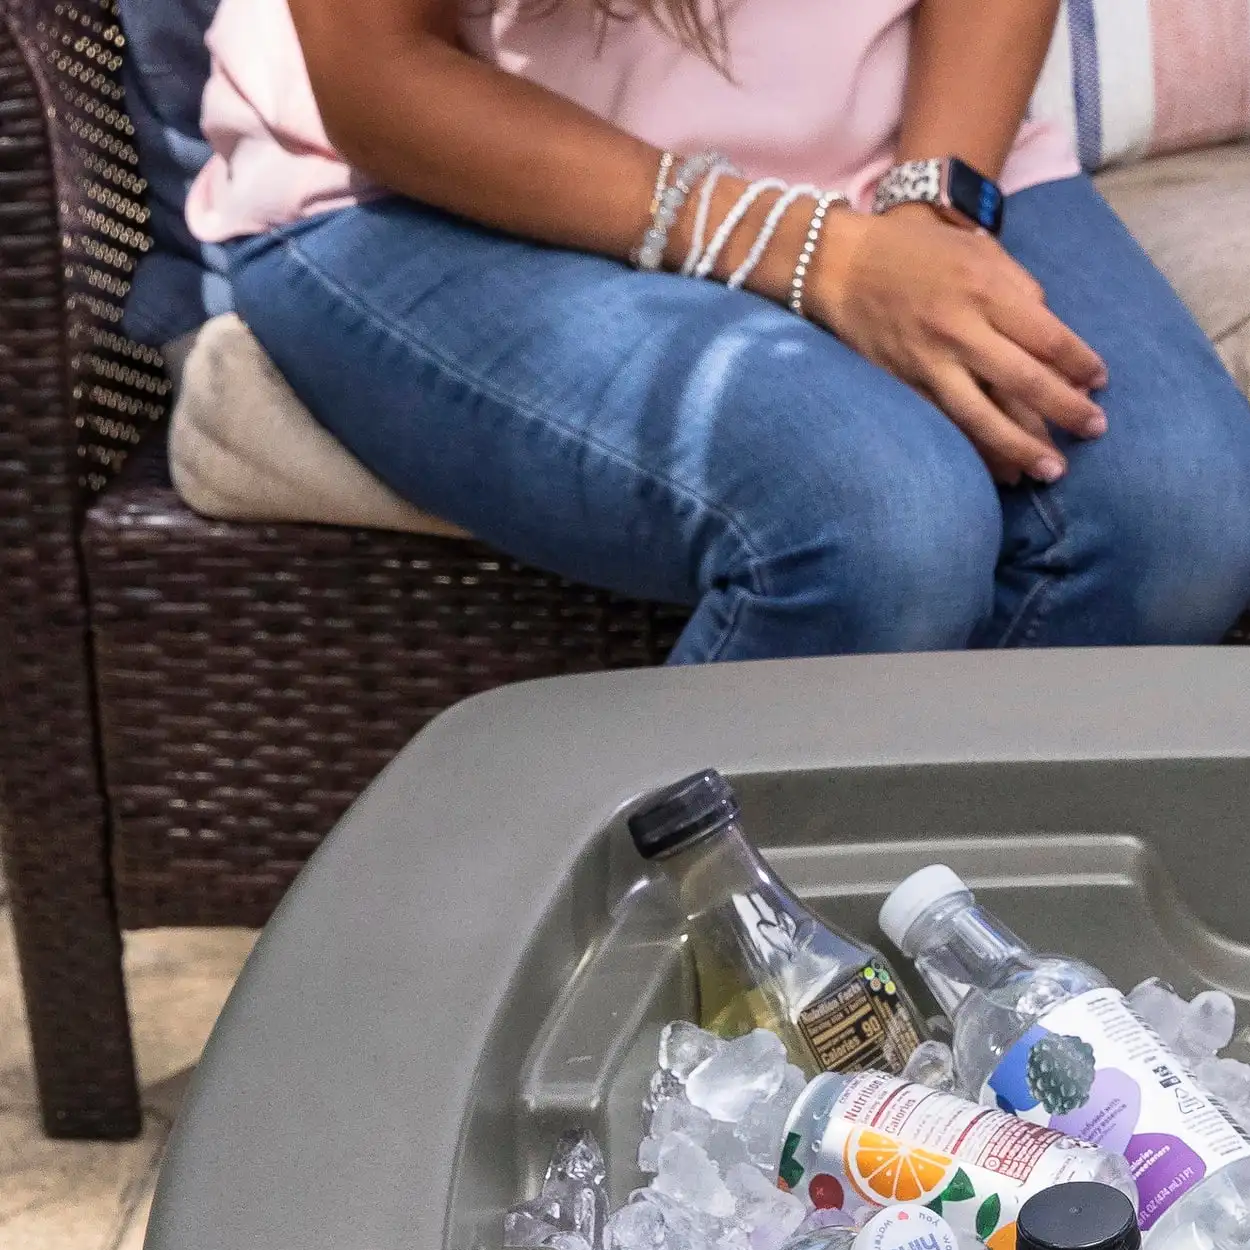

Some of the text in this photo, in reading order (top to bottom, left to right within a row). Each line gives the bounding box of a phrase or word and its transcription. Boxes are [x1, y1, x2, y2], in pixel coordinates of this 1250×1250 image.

[861, 1015, 881, 1038] 90
[843, 1077, 881, 1121] Nutrition
[884, 1099, 917, 1134] Calories
